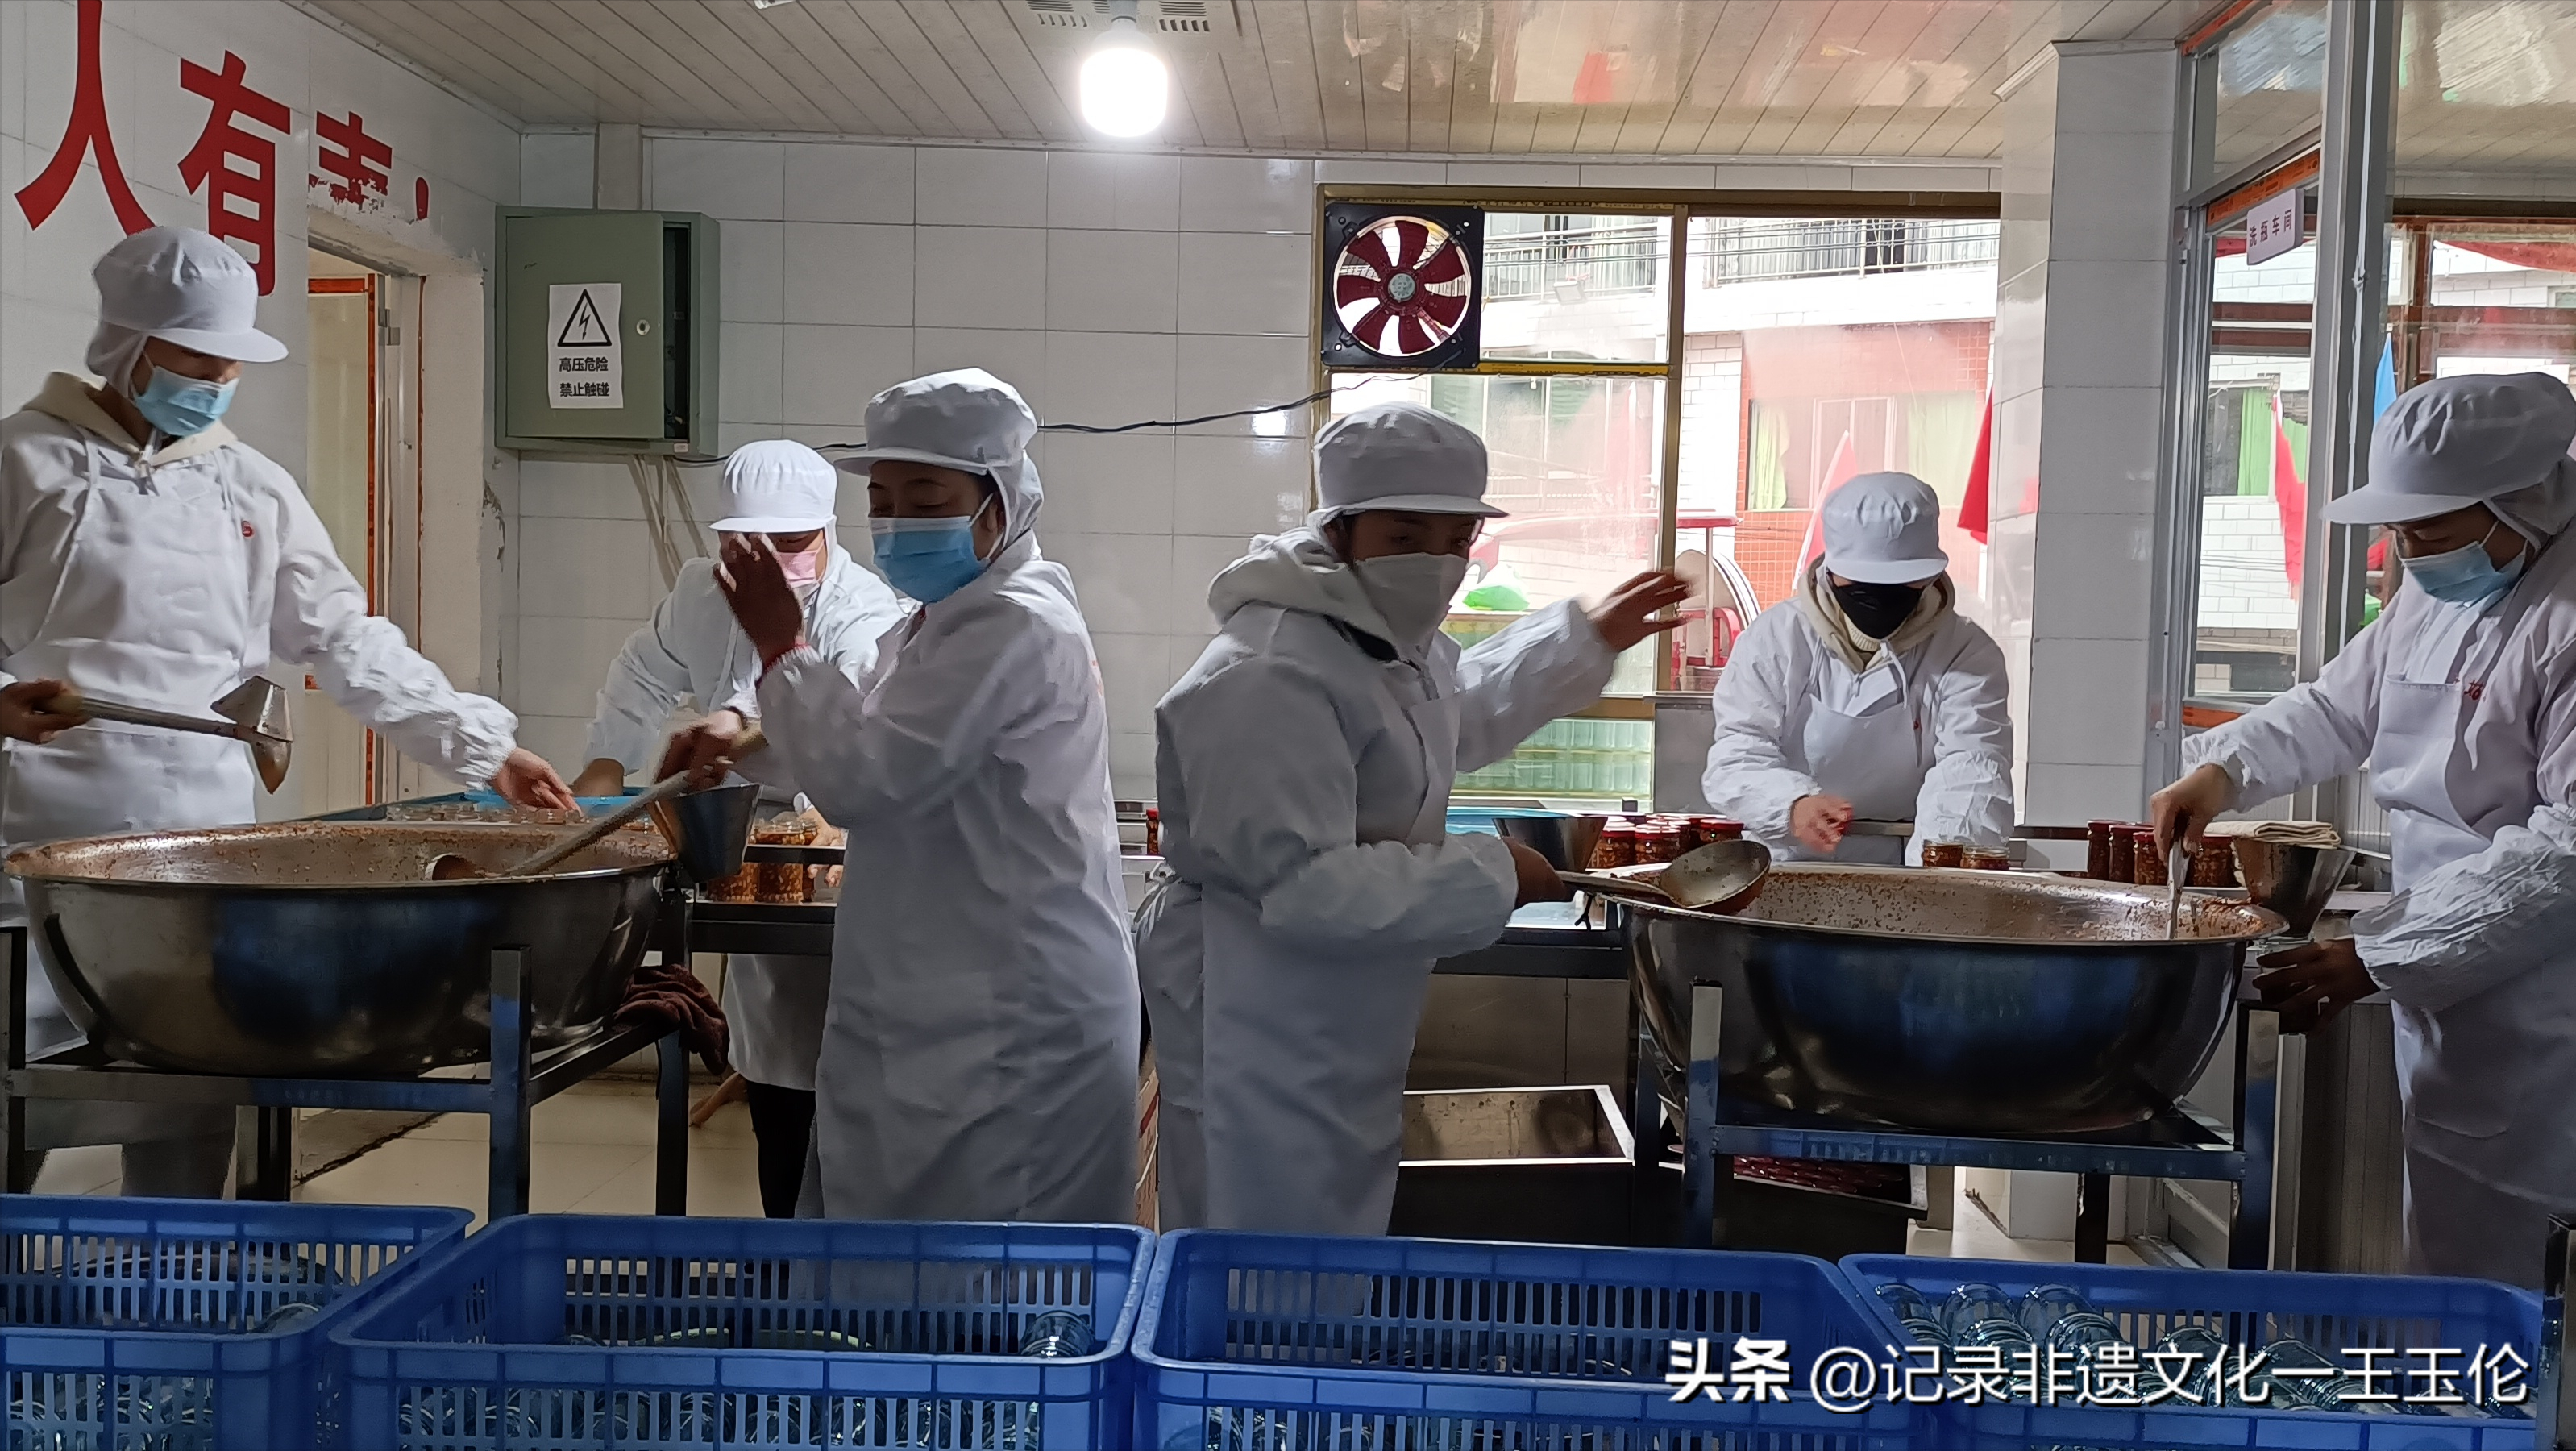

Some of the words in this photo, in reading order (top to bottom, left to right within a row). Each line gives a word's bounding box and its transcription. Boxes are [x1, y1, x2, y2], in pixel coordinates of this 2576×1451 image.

[559, 357, 609, 372] 高压危险
[559, 382, 609, 397] 禁止触碰
